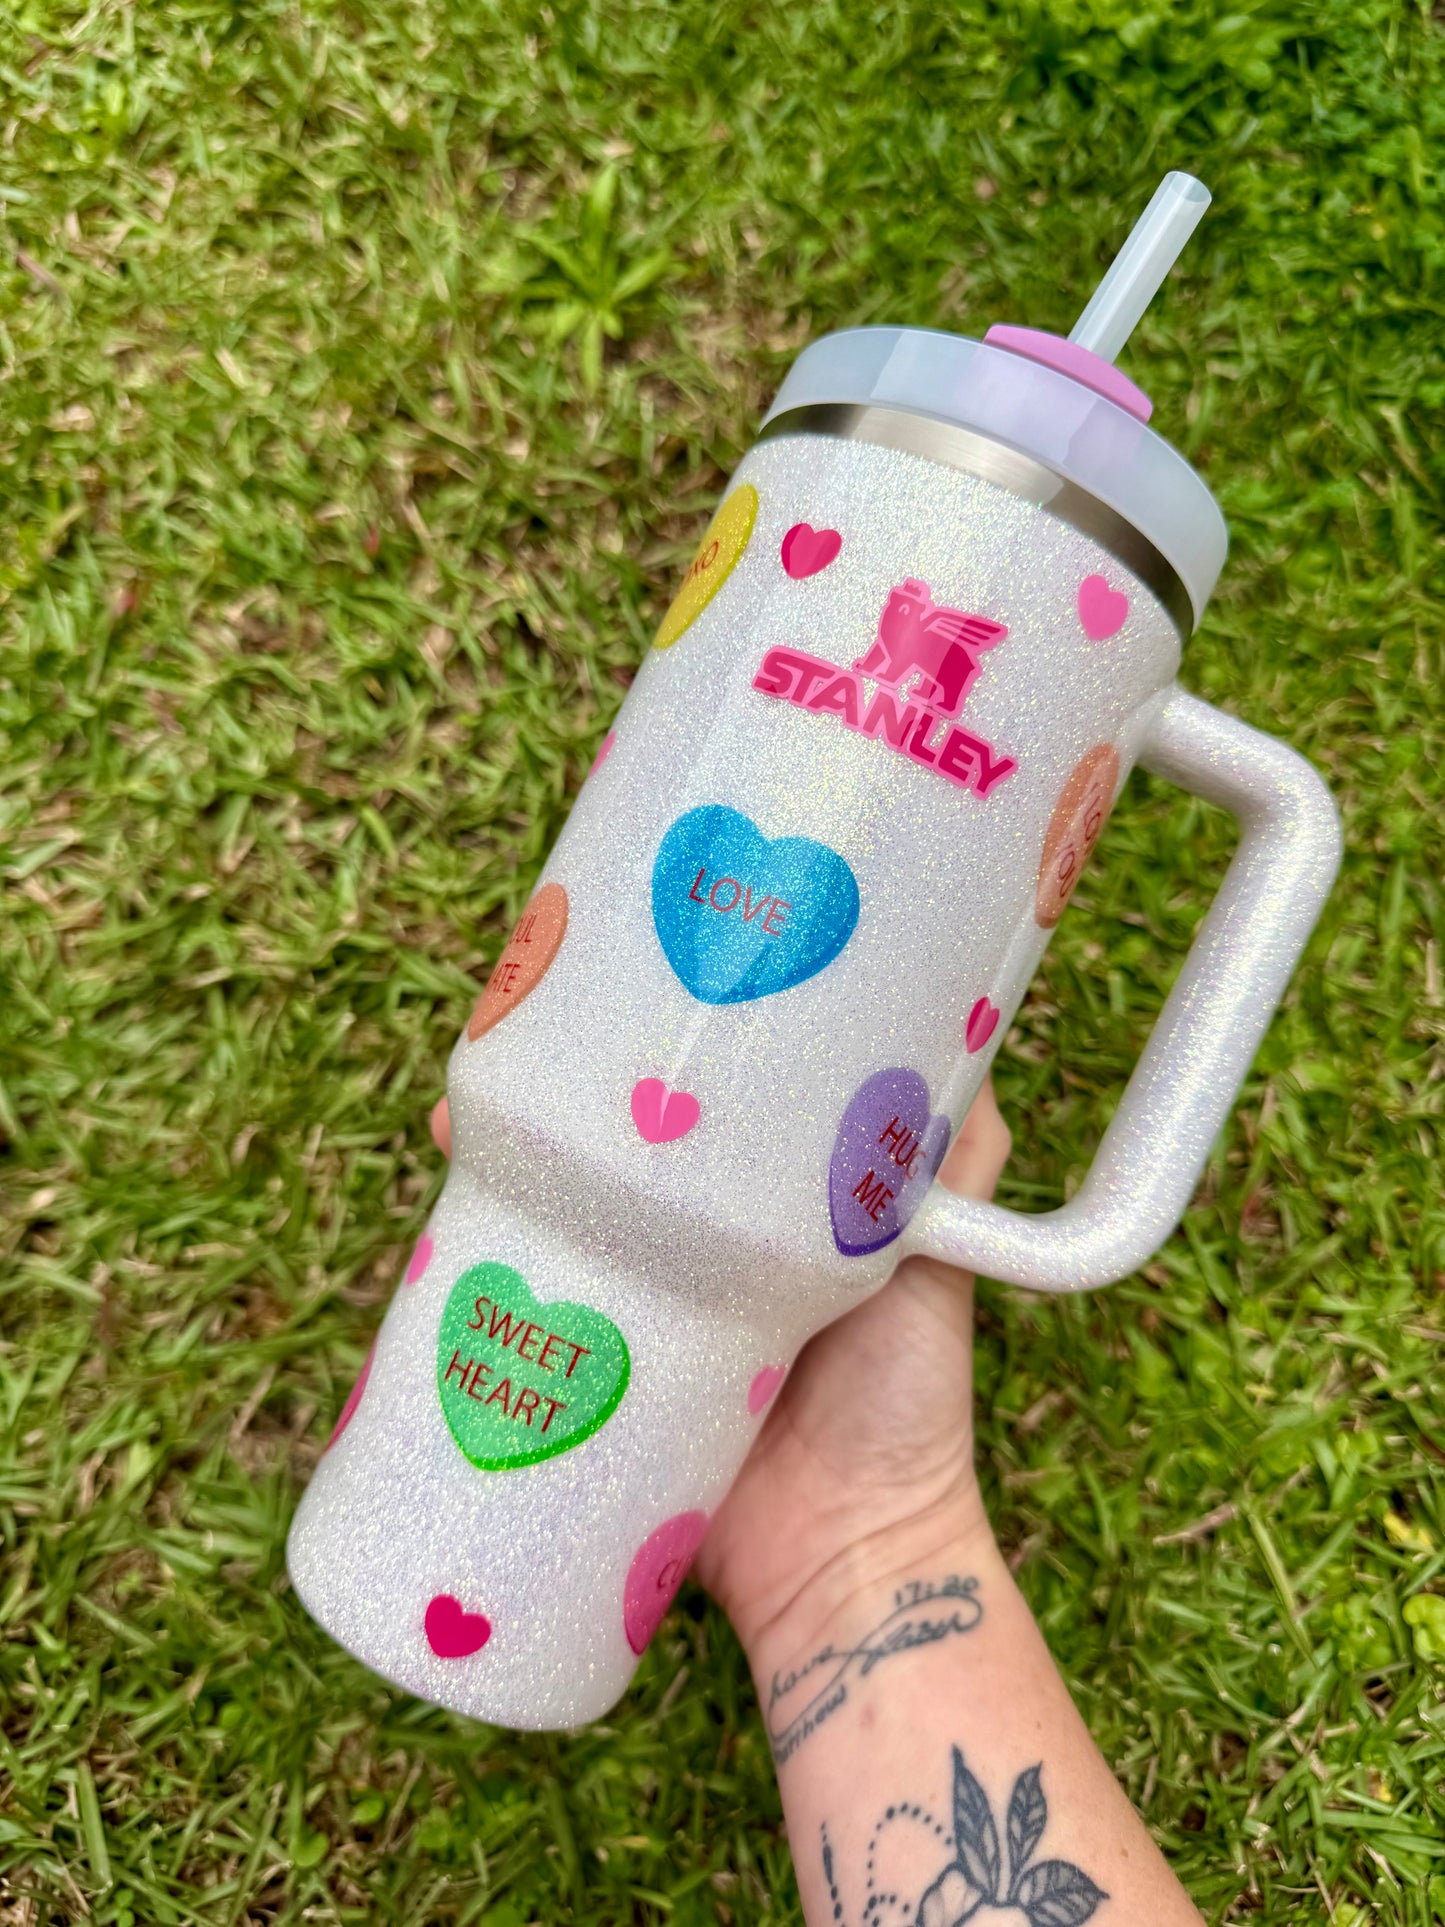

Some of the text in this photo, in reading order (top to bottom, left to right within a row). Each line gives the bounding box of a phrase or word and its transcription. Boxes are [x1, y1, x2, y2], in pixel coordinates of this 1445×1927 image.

[753, 650, 1015, 795] STANLEY
[688, 867, 792, 936] LOVE
[878, 1116, 927, 1181] HUG
[852, 1170, 894, 1222] ME
[466, 1296, 591, 1379] SWEET
[444, 1348, 567, 1434] HEART
